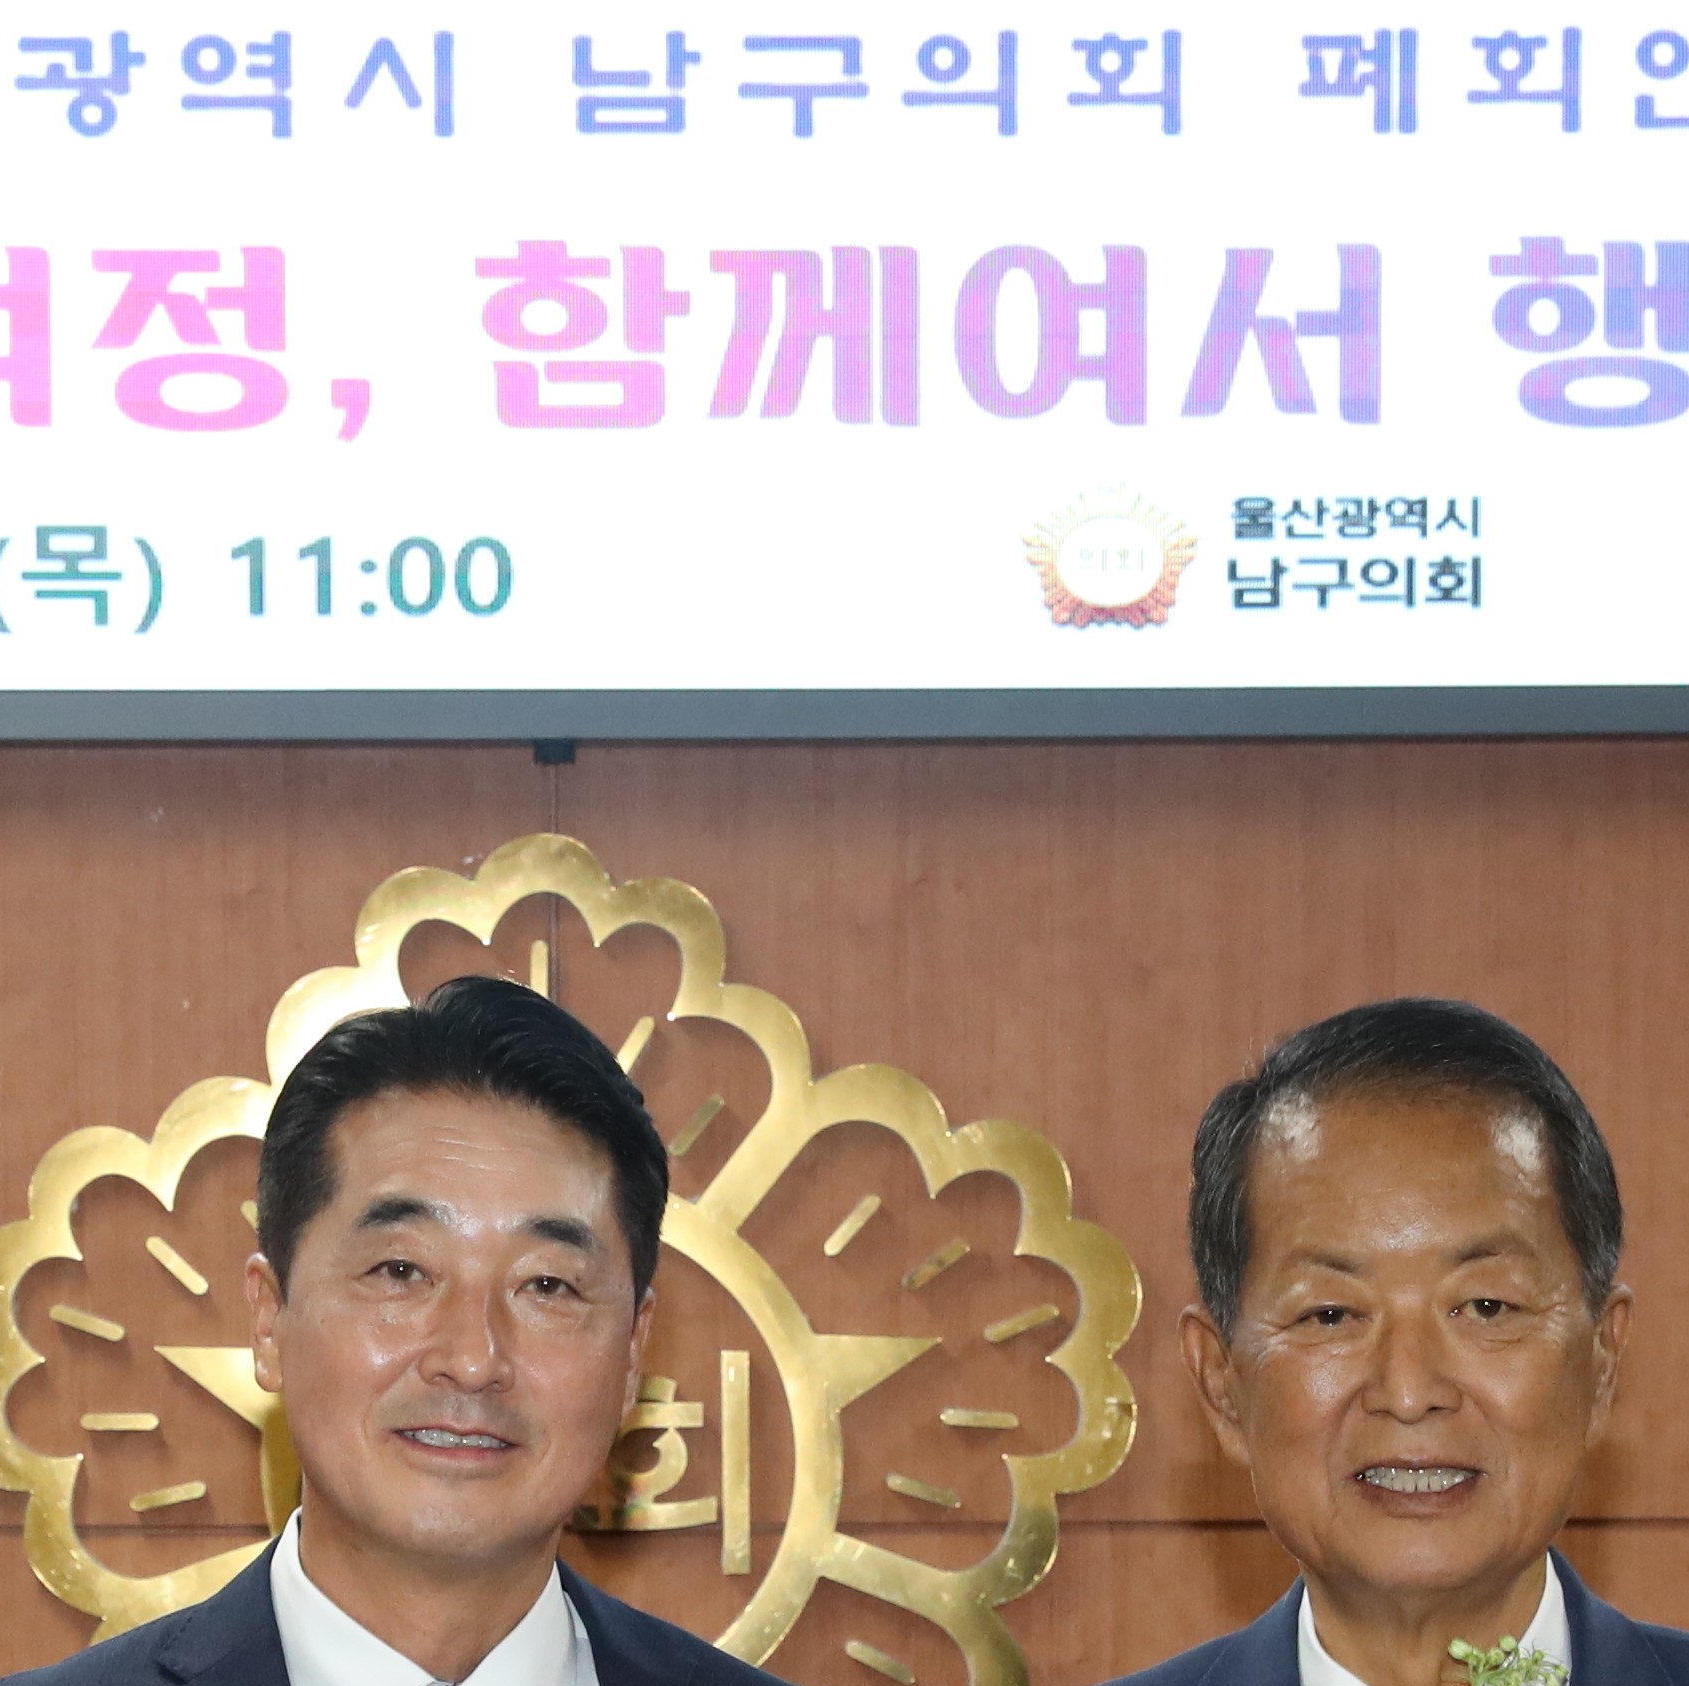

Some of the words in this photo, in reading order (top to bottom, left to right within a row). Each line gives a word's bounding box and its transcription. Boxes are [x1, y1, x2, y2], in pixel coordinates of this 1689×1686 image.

[571, 28, 1183, 140] 남구의회
[474, 239, 1383, 430] 함께여서
[1231, 496, 1481, 541] 울산광역시
[230, 536, 514, 618] 11:00
[1227, 554, 1482, 611] 남구의회
[563, 1348, 753, 1577] 회
